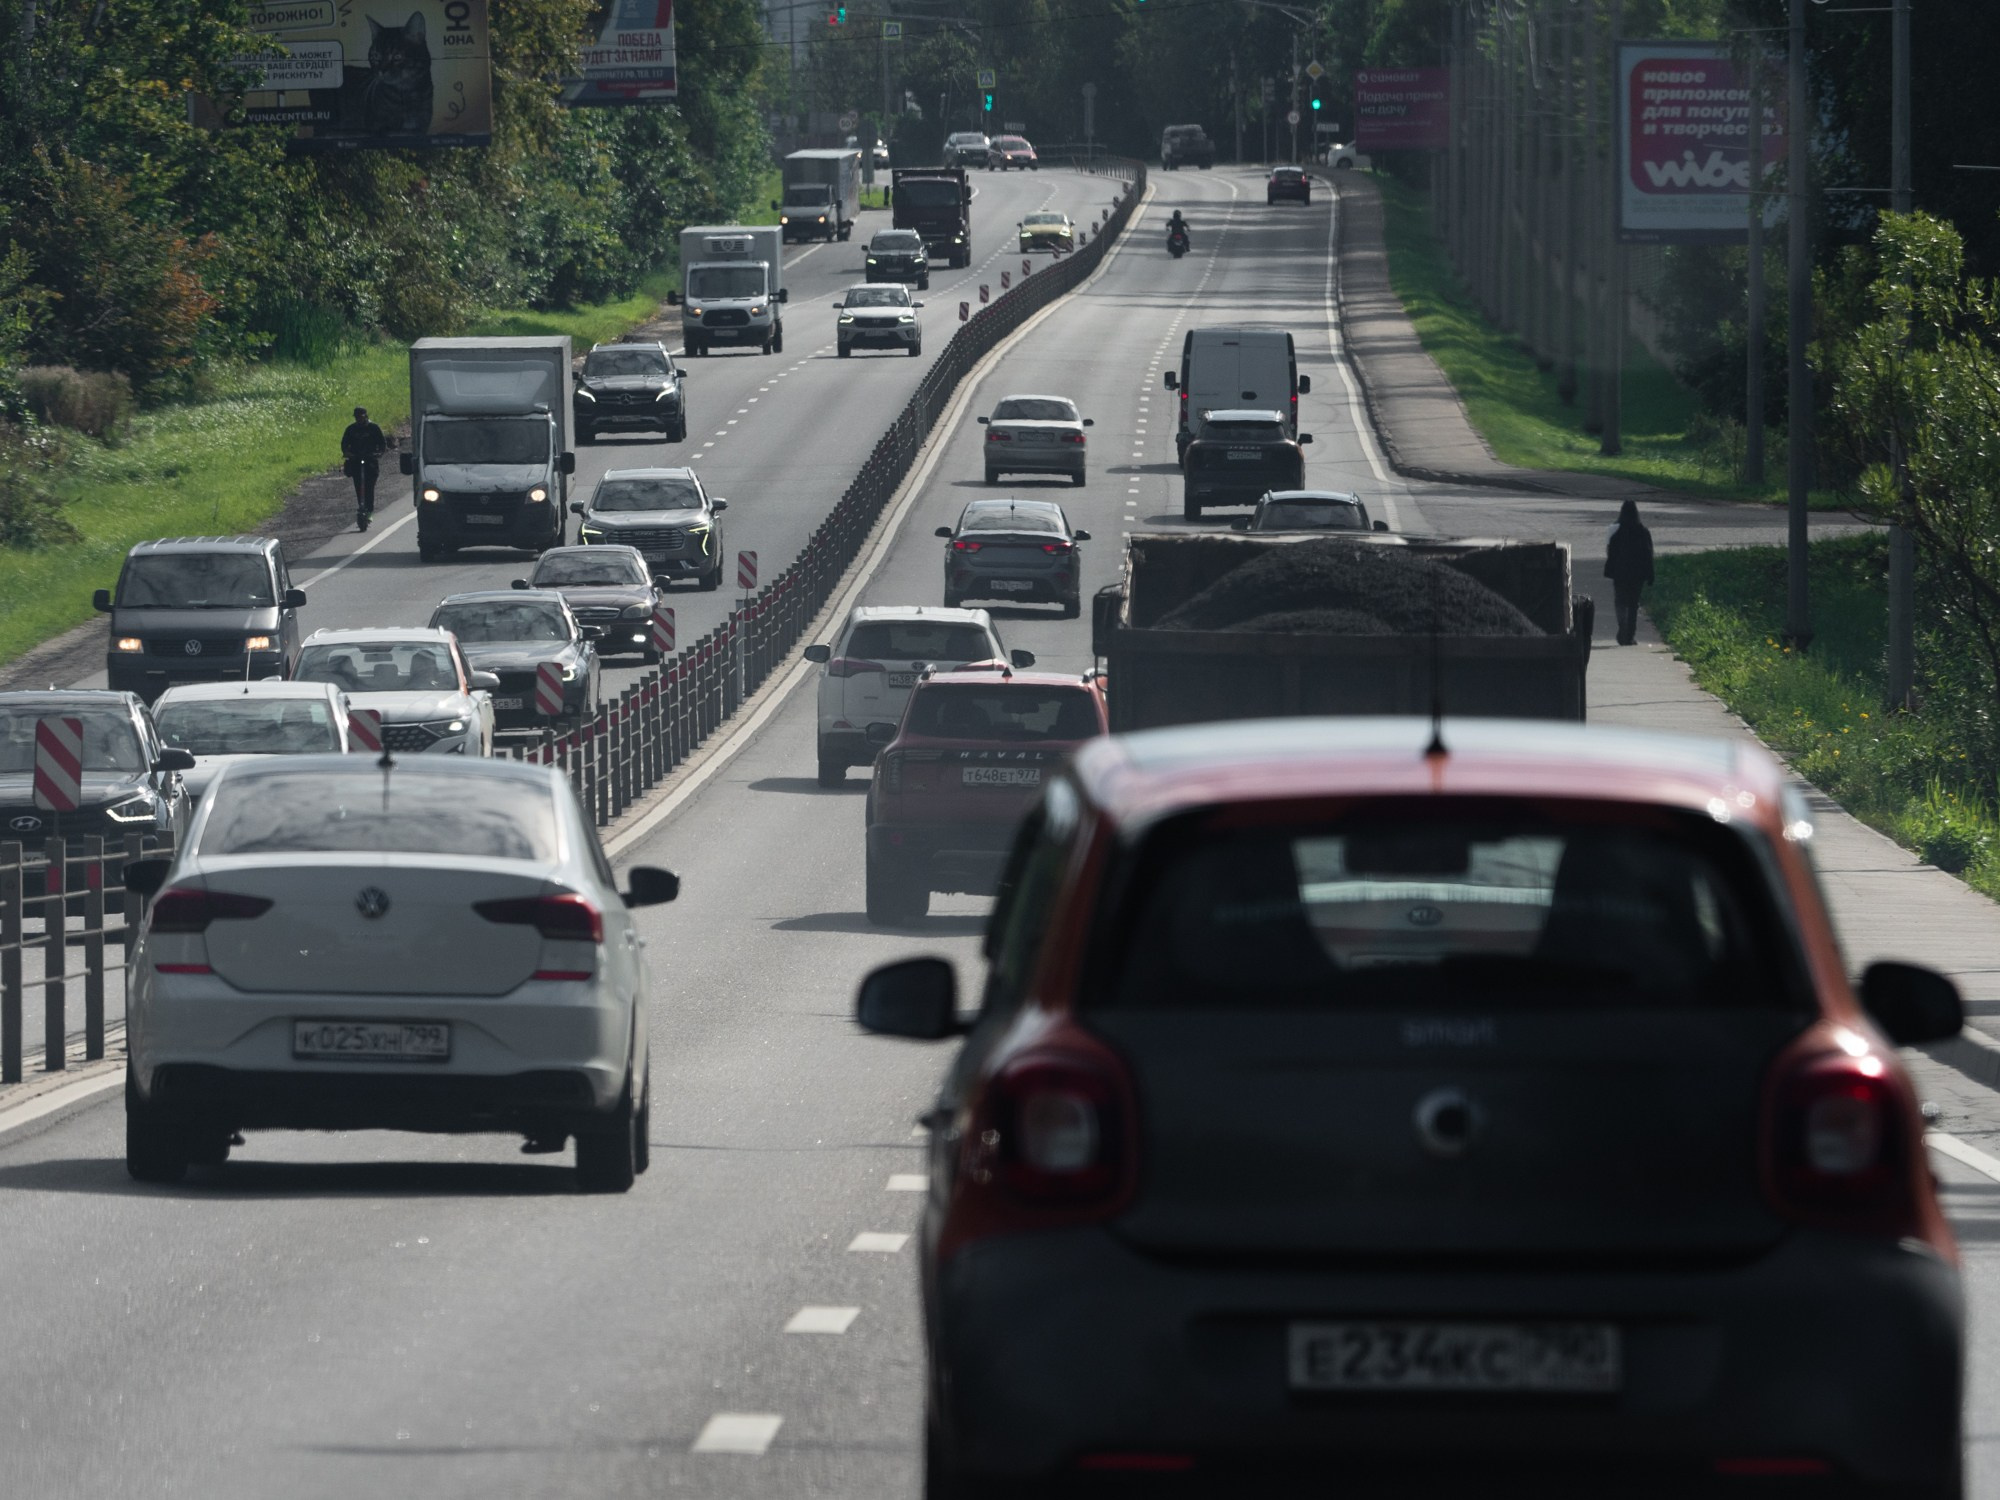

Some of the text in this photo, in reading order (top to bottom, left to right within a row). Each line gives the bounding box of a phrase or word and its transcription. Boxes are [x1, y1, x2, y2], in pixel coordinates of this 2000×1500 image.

[251, 8, 324, 25] ТОРОЖНО!
[443, 34, 475, 46] ЮНА
[618, 33, 662, 47] ПОБЕДА
[298, 51, 332, 60] МОЖЕТ
[614, 50, 629, 63] ЗА
[631, 50, 662, 63] НАМИ
[267, 61, 292, 70] ВАШЕ
[272, 71, 323, 80] РИСКНУТЬ?
[1641, 71, 1705, 84] новое
[1357, 90, 1403, 103] Подача
[1641, 88, 1769, 104] приложен
[248, 110, 331, 122] YUNACENTER.RU
[1359, 106, 1375, 115] на
[1641, 106, 1775, 122] для покупк
[1642, 124, 1784, 139] и творчесва
[960, 751, 1044, 760] HAVAL
